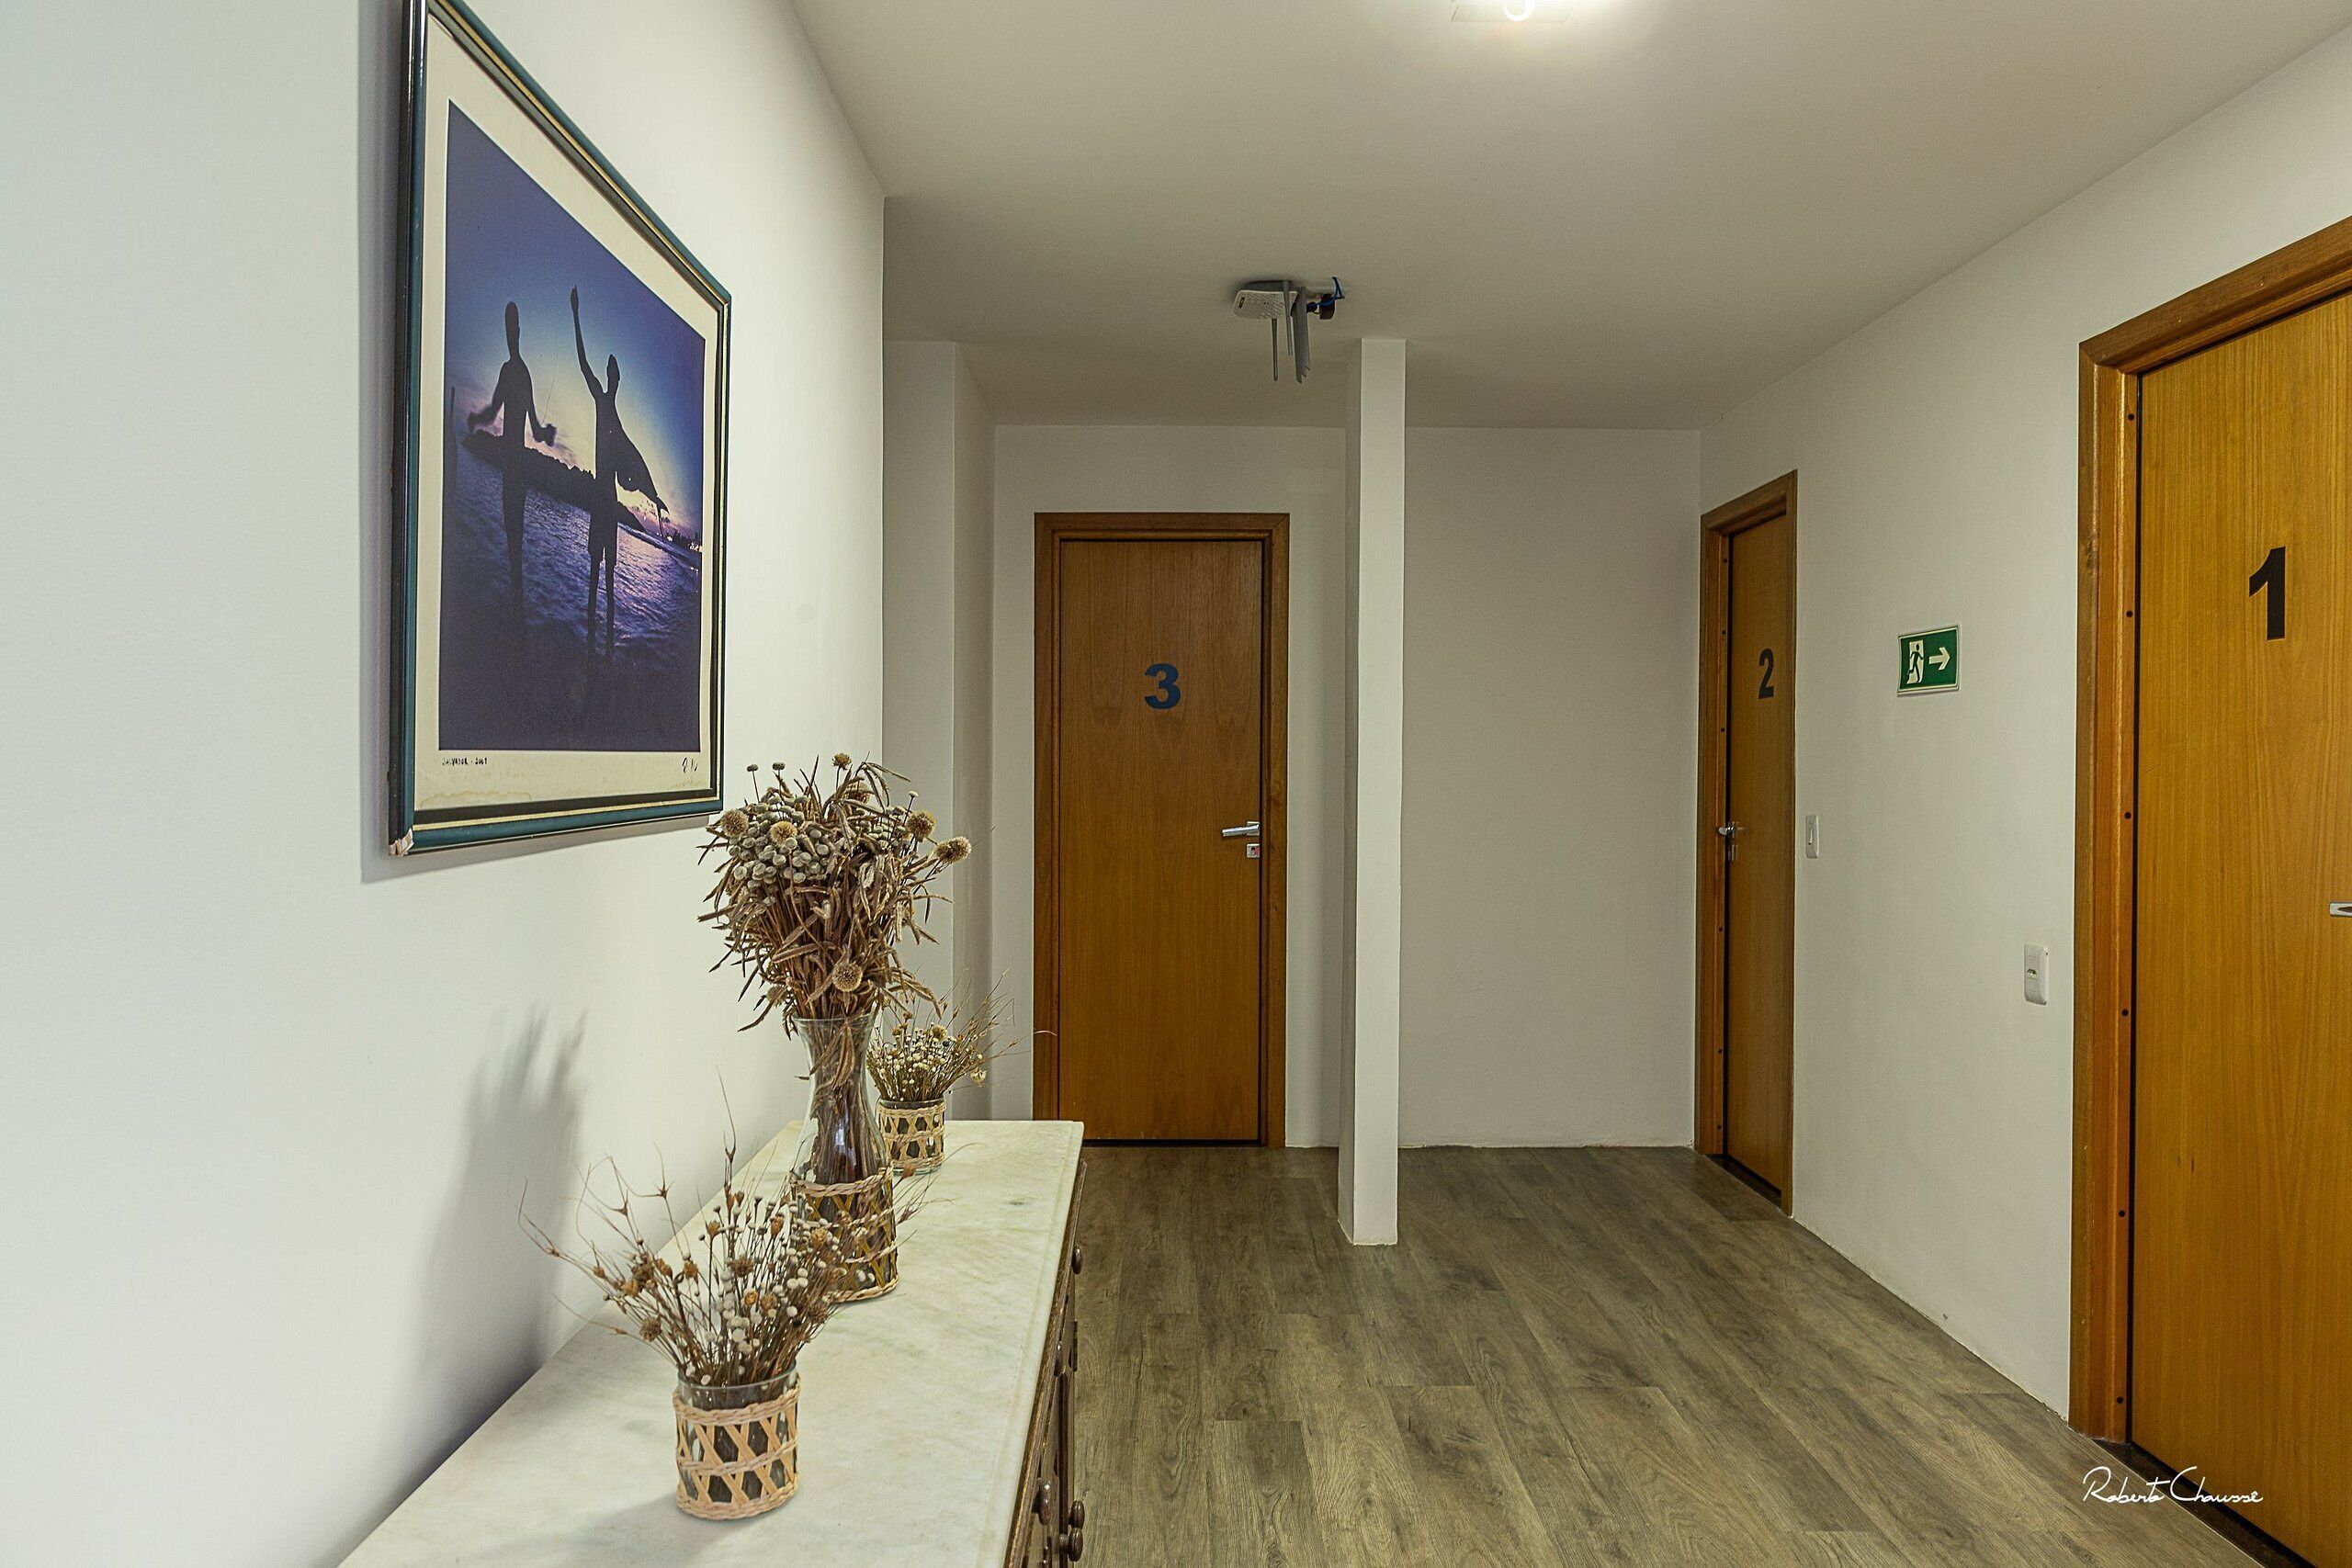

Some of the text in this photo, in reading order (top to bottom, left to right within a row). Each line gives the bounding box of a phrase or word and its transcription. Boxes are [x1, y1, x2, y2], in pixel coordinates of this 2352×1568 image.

[2249, 546, 2286, 640] 1
[1144, 663, 1181, 709] 3
[1758, 649, 1774, 700] 2
